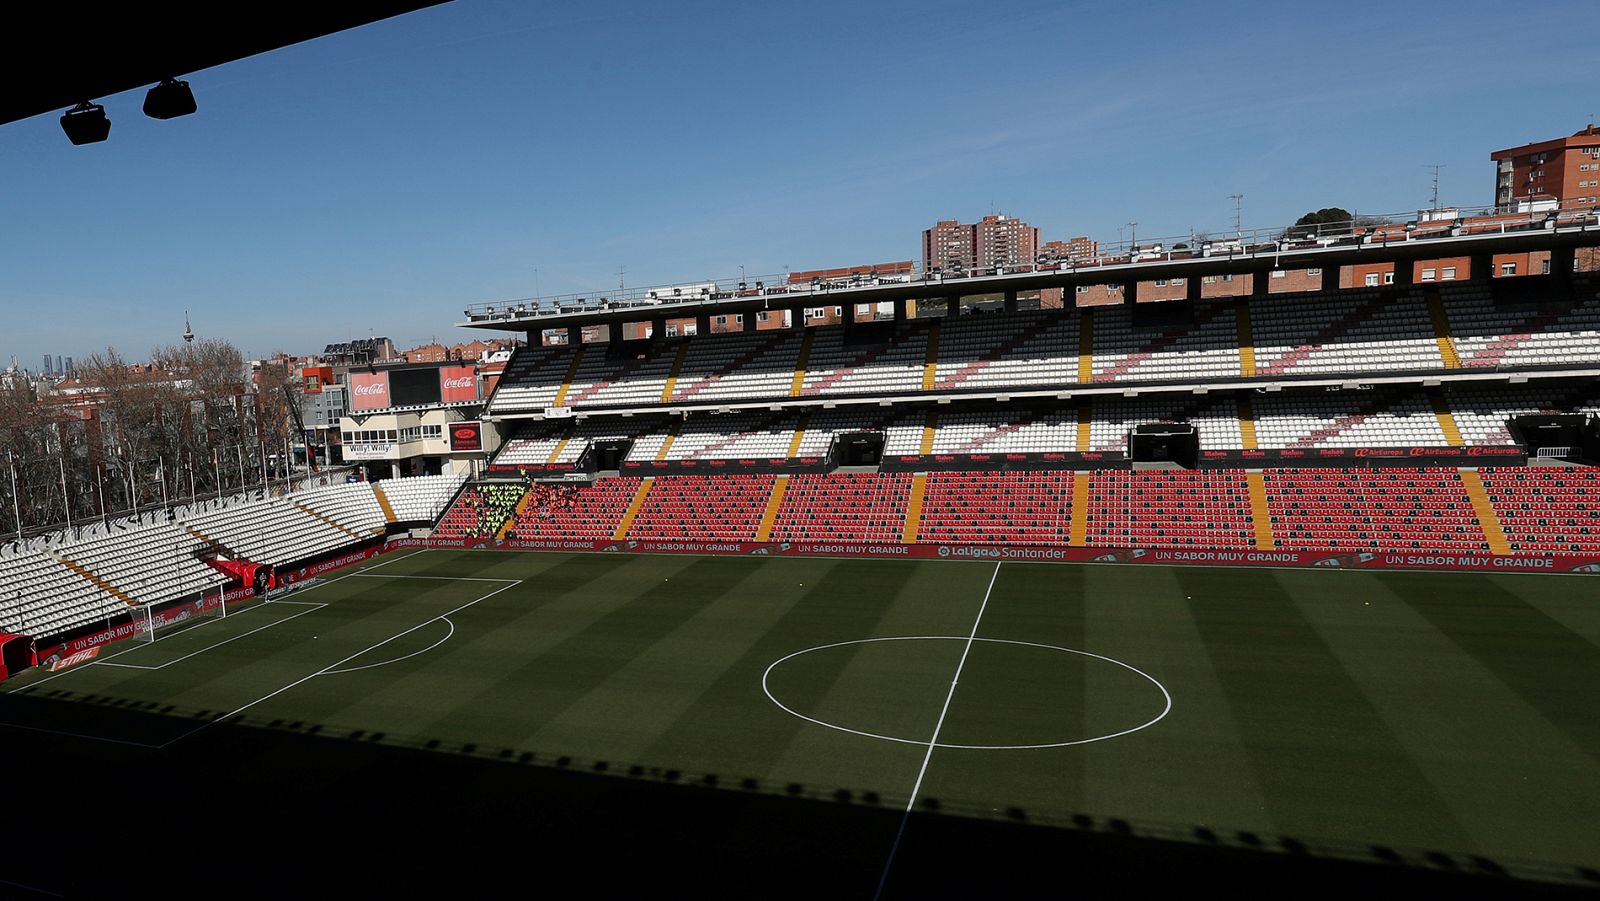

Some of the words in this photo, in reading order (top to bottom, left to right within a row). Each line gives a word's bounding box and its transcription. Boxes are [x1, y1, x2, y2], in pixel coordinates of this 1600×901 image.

[846, 546, 868, 554] MUY
[952, 547, 988, 557] LaLiga
[1002, 548, 1066, 558] Santander
[1155, 552, 1171, 560] UN
[1174, 552, 1215, 560] SABOR
[1218, 552, 1243, 561] MUY
[1247, 553, 1298, 562] GRANDE
[1386, 556, 1404, 564] UN
[1407, 556, 1455, 565] SABOR
[1458, 557, 1490, 566] MUY
[1493, 558, 1553, 568] GRANDE
[208, 598, 218, 606] UN
[74, 640, 87, 650] UN
[88, 630, 116, 646] SABOR
[117, 624, 134, 637] MUY
[59, 650, 93, 668] STIHL
